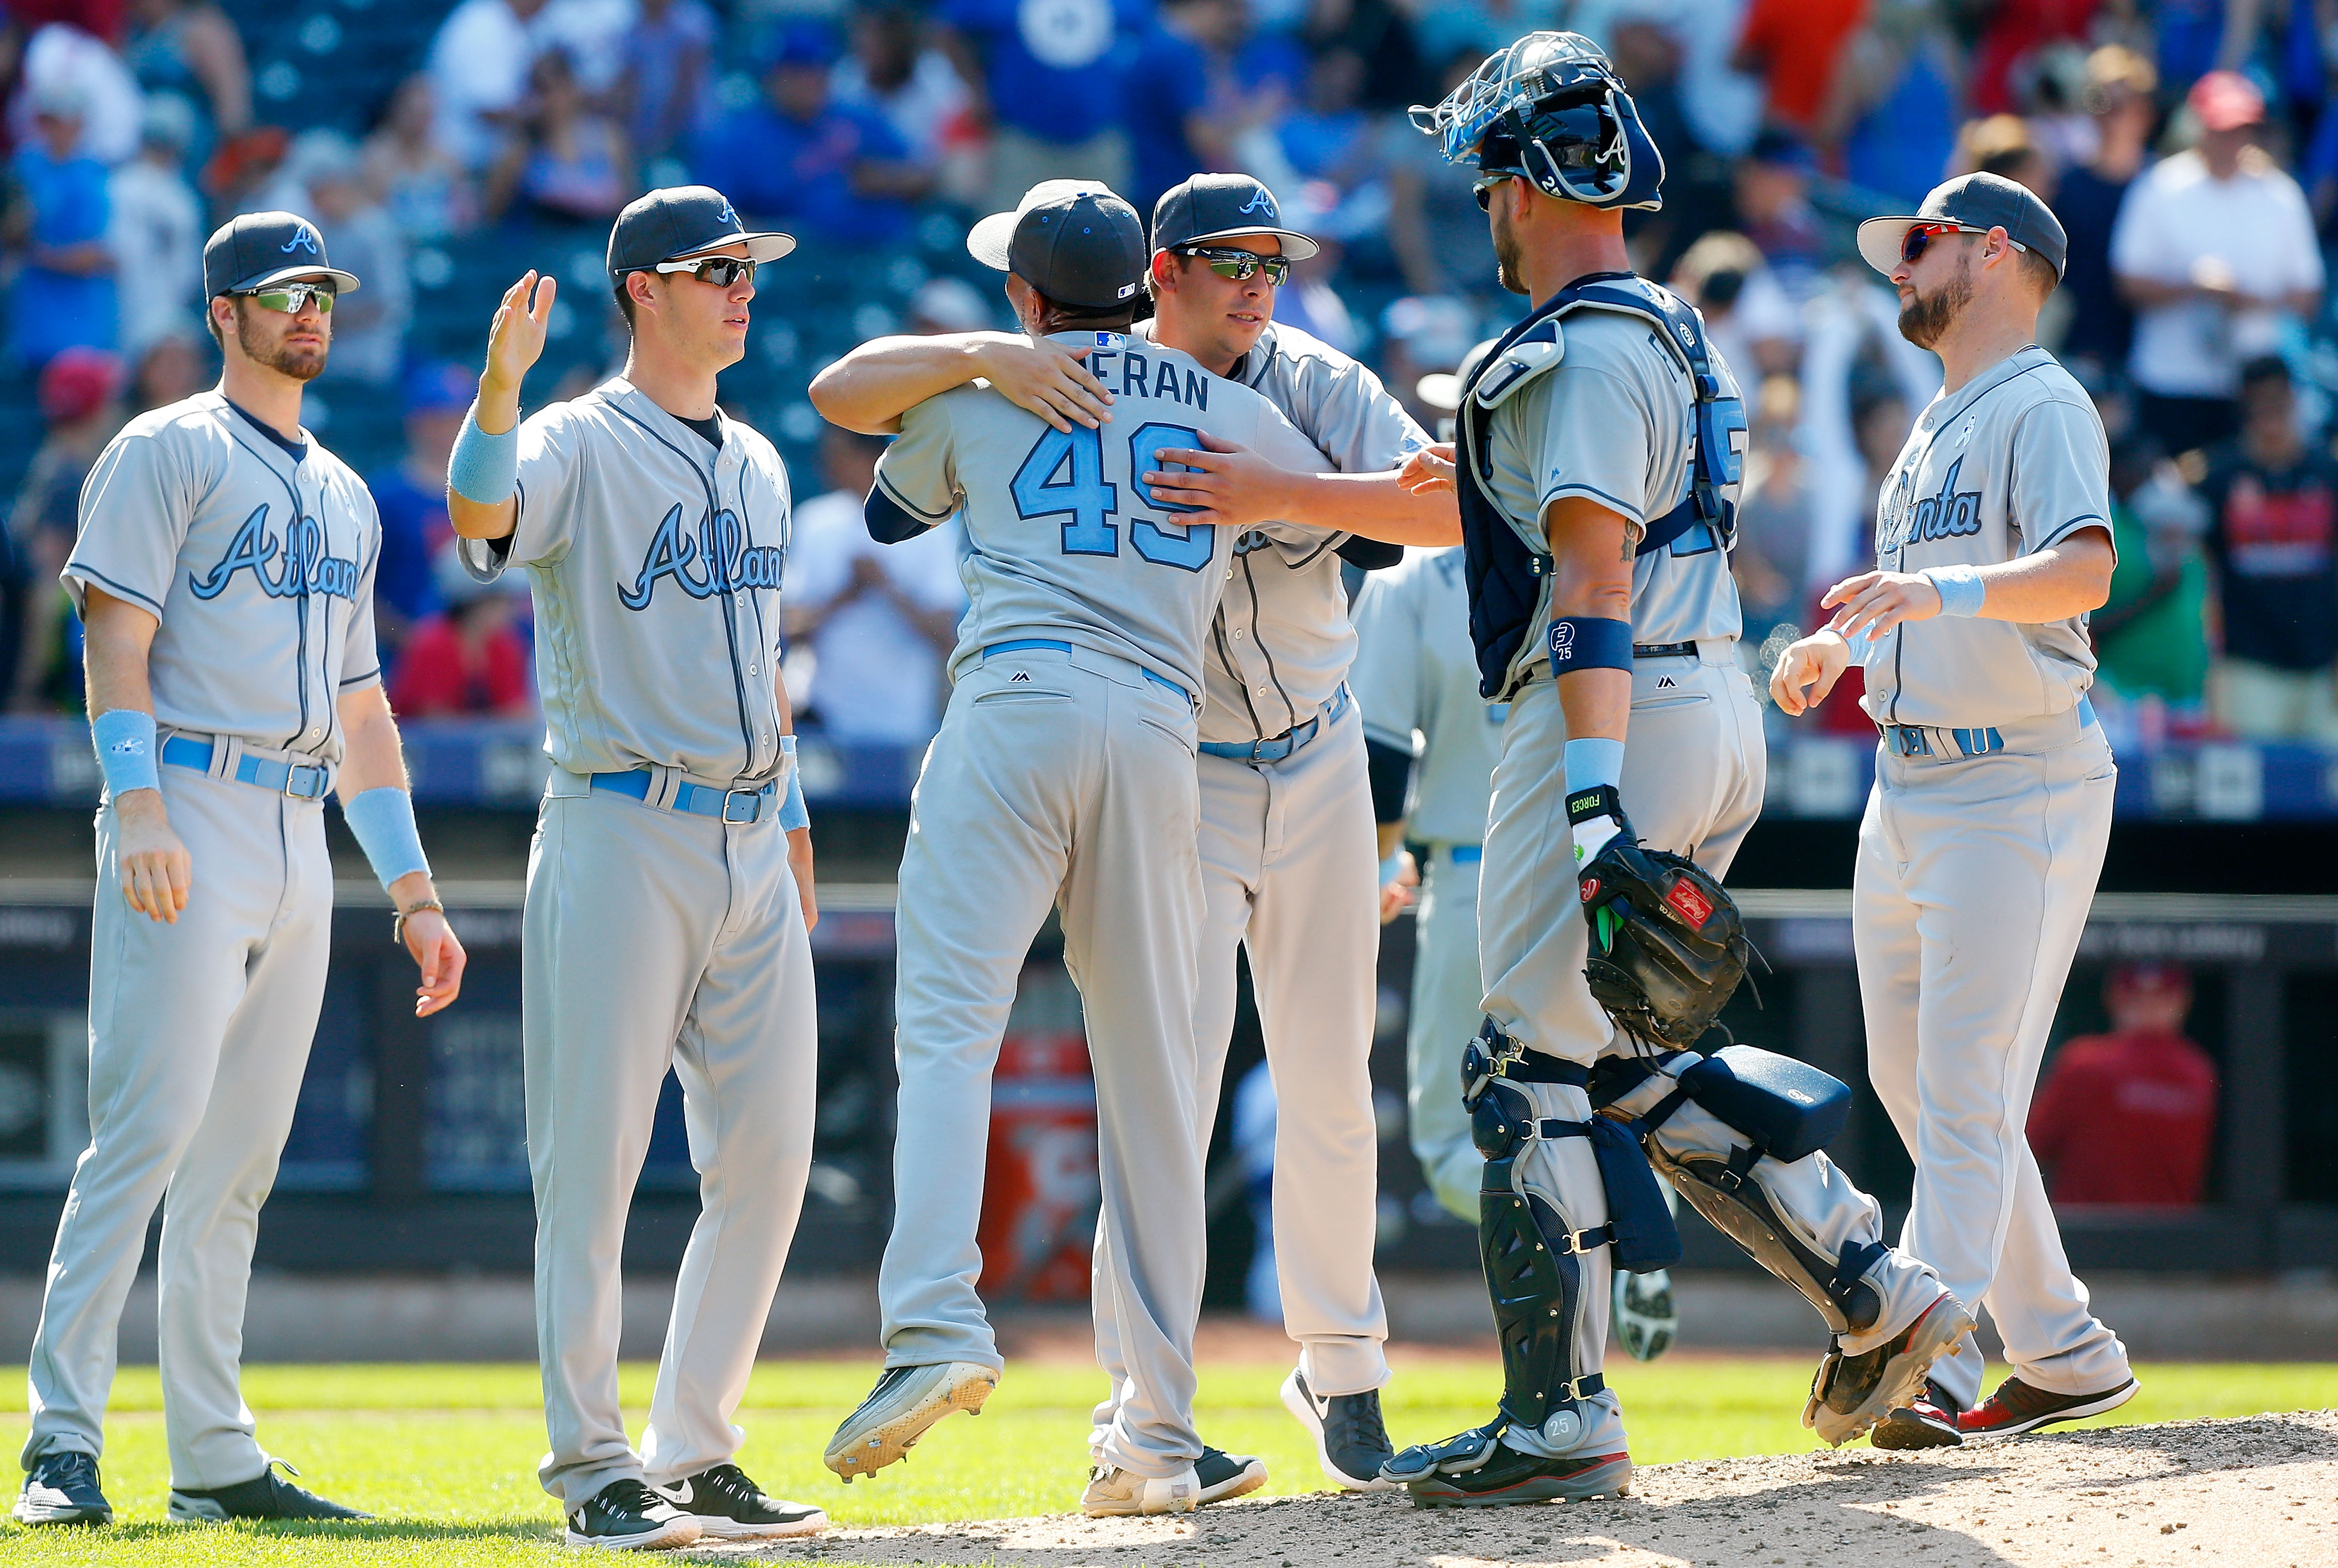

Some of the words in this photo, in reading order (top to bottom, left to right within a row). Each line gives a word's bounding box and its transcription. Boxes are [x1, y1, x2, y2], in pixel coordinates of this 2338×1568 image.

[1238, 186, 1275, 219] A
[280, 223, 318, 255] A
[1079, 351, 1209, 412] ERAN
[1008, 413, 1217, 574] 49
[1558, 647, 1572, 660] 25
[1572, 794, 1600, 814] FORCE3
[1675, 891, 1705, 919] Rawlings
[1550, 1418, 1569, 1437] 25
